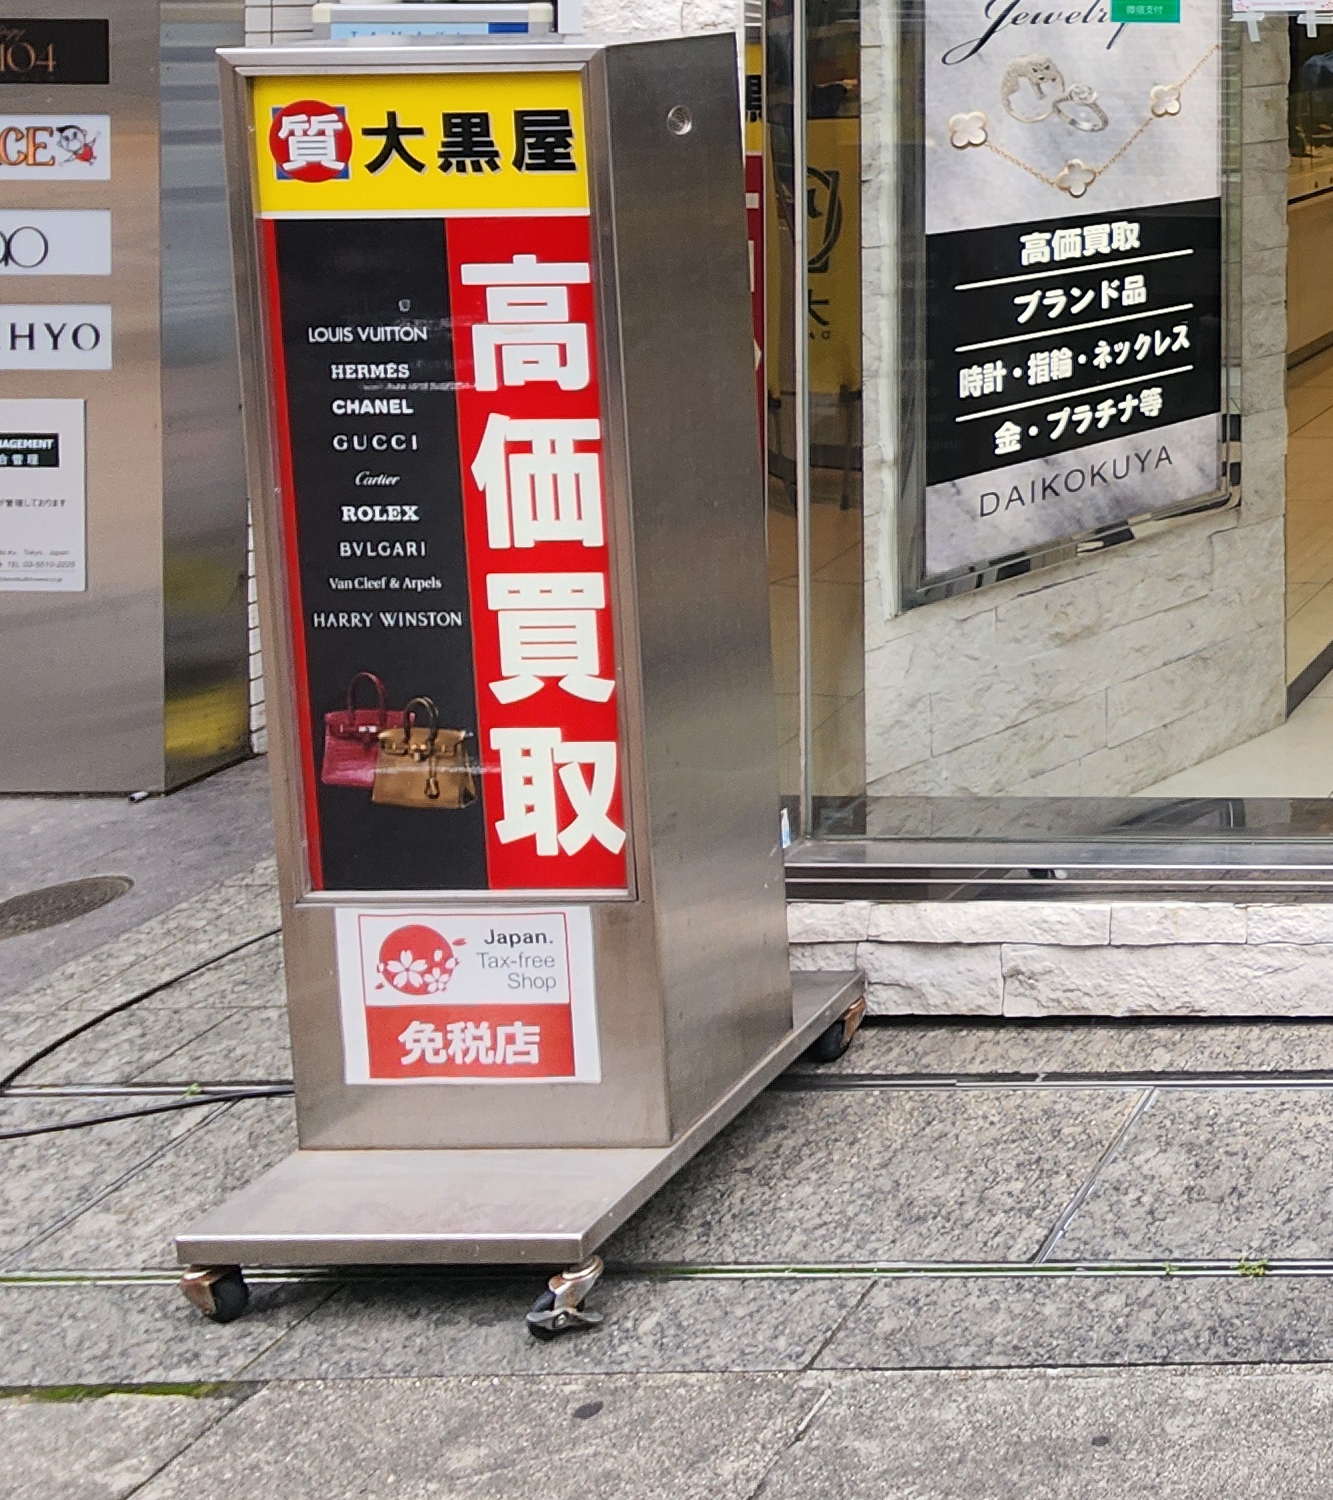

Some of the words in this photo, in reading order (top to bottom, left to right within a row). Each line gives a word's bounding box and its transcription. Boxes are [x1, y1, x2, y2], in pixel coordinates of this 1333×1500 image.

[277, 111, 345, 173] 質
[360, 108, 577, 175] 大黒屋
[1020, 221, 1141, 266] 高価買取
[1014, 274, 1148, 325] ブランド品
[308, 326, 353, 342] LOUIS
[357, 325, 428, 342] VUITTON
[332, 398, 414, 416] CHANEL
[994, 386, 1164, 456] 金・プラチナ等
[332, 435, 418, 452] GUCCI
[354, 470, 400, 488] Cartier
[978, 443, 1175, 518] DAIKOKUYA
[341, 504, 420, 522] ROLEX
[339, 540, 426, 557] BVLGARI
[460, 255, 627, 857] 高価買取
[329, 575, 352, 591] Van
[354, 575, 386, 591] Cleef
[389, 575, 400, 591] &
[402, 575, 442, 592] Arpels
[313, 611, 376, 628] HARRY
[379, 610, 463, 628] WINSTON
[484, 928, 554, 947] Japan.
[476, 951, 556, 971] Tax-free
[507, 972, 557, 993] Shop
[398, 1019, 541, 1067] 免税店
